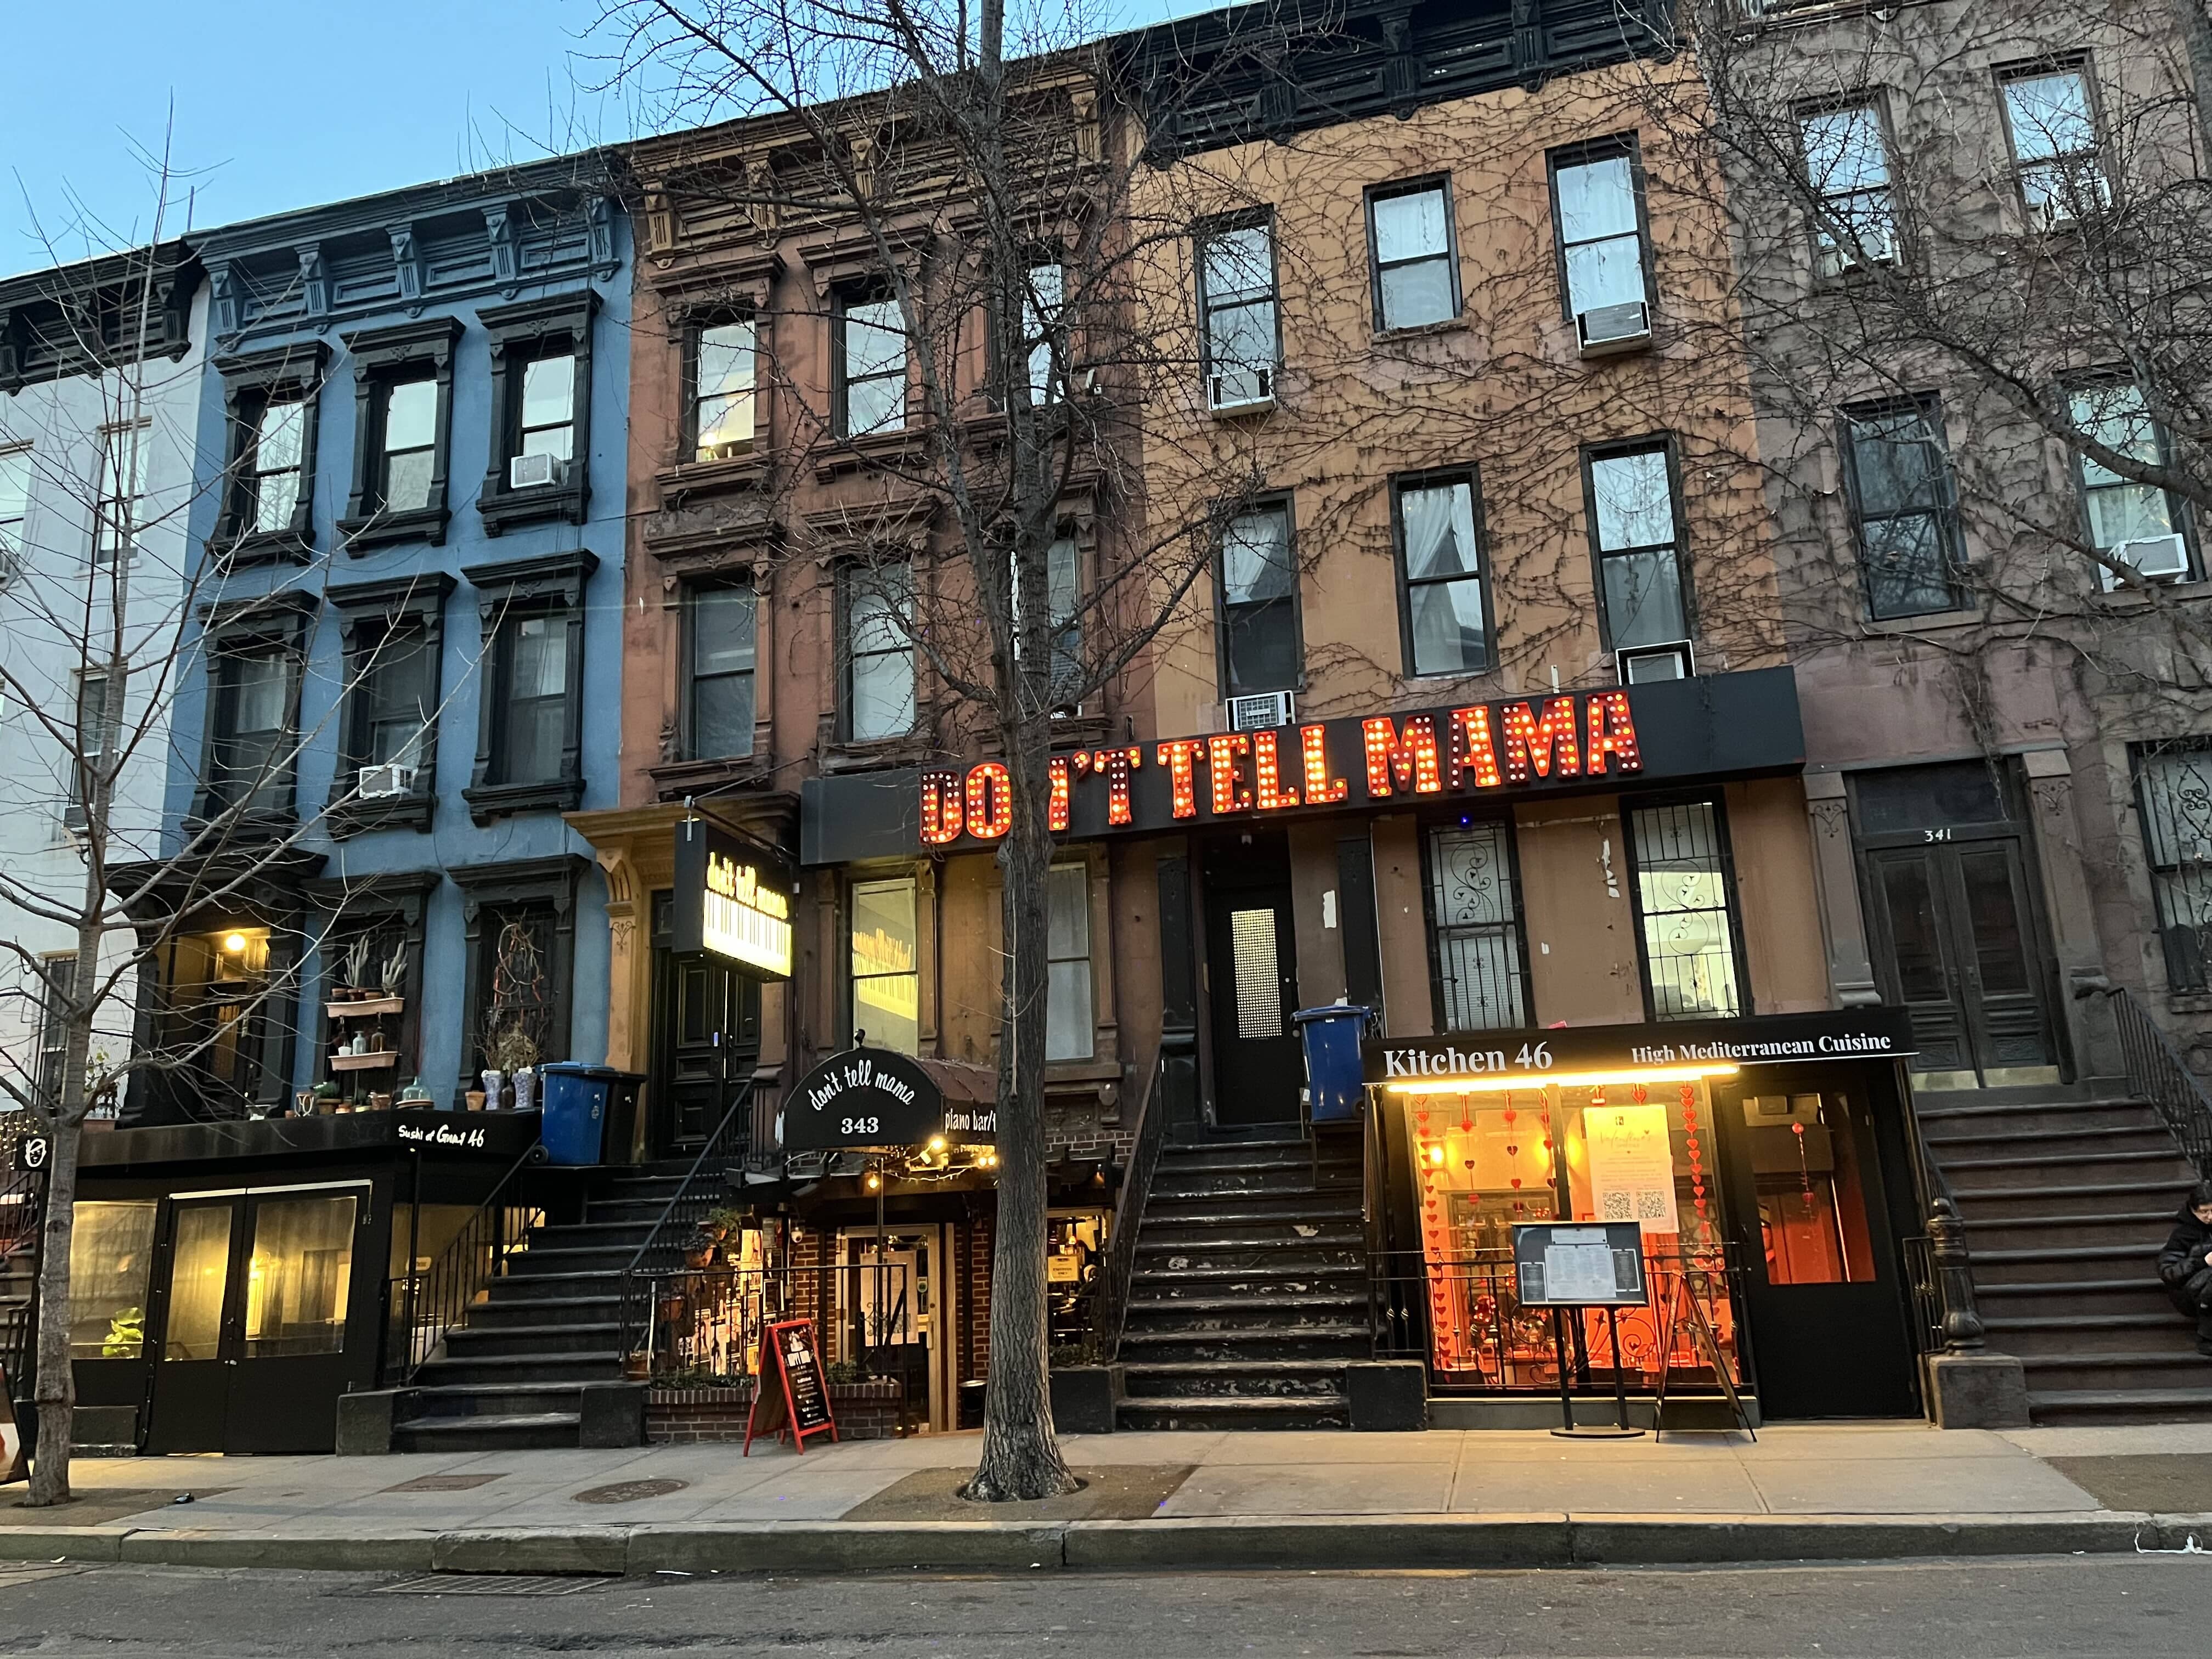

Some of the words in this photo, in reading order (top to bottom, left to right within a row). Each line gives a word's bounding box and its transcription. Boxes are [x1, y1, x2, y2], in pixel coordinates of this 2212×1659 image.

[919, 746, 1141, 844] DO'T
[1157, 724, 1347, 819] TELL
[1362, 690, 1643, 798] MAMA
[1924, 828, 1951, 842] 341
[1383, 1046, 1508, 1077] Kitchen
[1514, 1041, 1553, 1070] 46
[1631, 1044, 1675, 1066] High
[1679, 1040, 1815, 1061] Mediterranean
[1818, 1032, 1892, 1053] Cuisine
[808, 1071, 843, 1111] don't
[844, 1059, 872, 1088] tell
[874, 1071, 915, 1105] mama
[840, 1116, 879, 1134] 343
[945, 1107, 970, 1135] piano
[467, 1128, 485, 1148] 46
